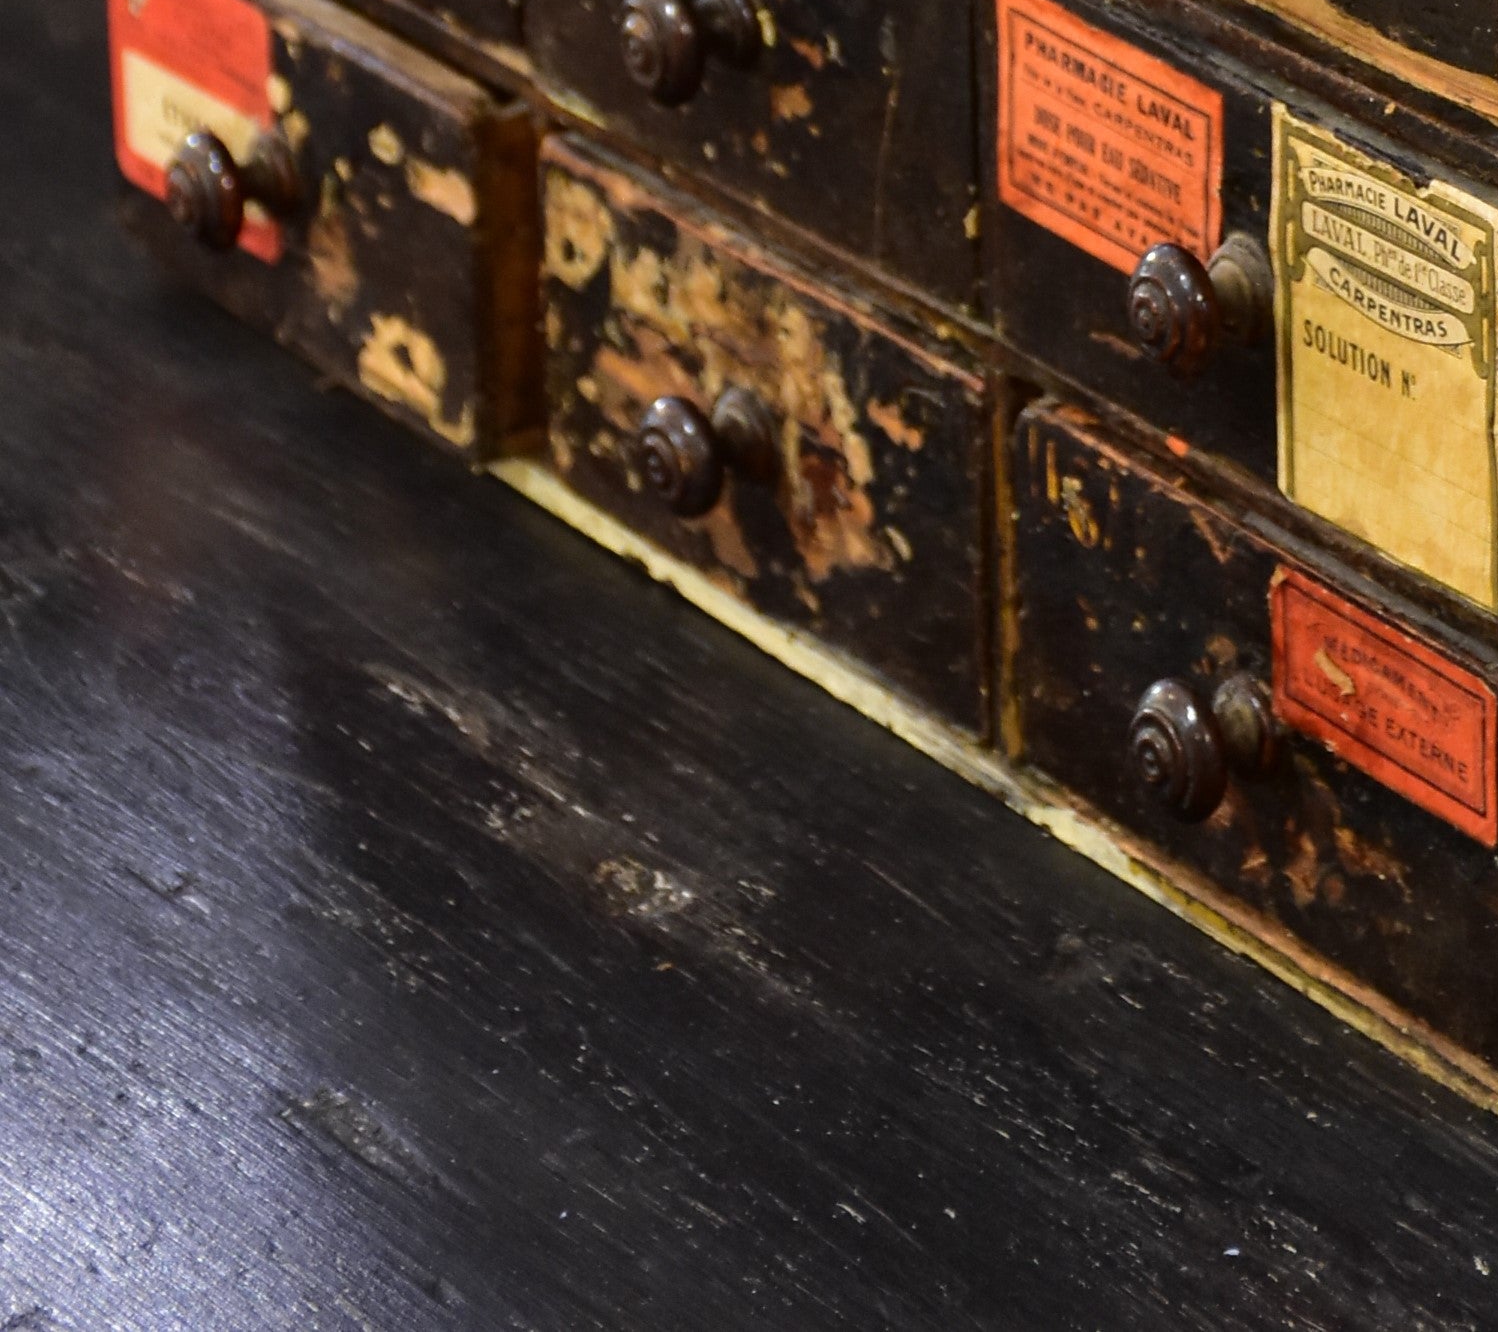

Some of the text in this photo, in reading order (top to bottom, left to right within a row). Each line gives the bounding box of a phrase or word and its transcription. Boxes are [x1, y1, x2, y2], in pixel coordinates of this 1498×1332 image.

[1024, 30, 1127, 105] PHARMACIE
[1136, 93, 1195, 142] LAVAL
[1308, 170, 1461, 262] PHARMACIE LAVAL
[1329, 267, 1447, 337] CARPENTRAS
[1303, 319, 1391, 388] SOLUTION
[1385, 716, 1468, 783] EXTERNE
